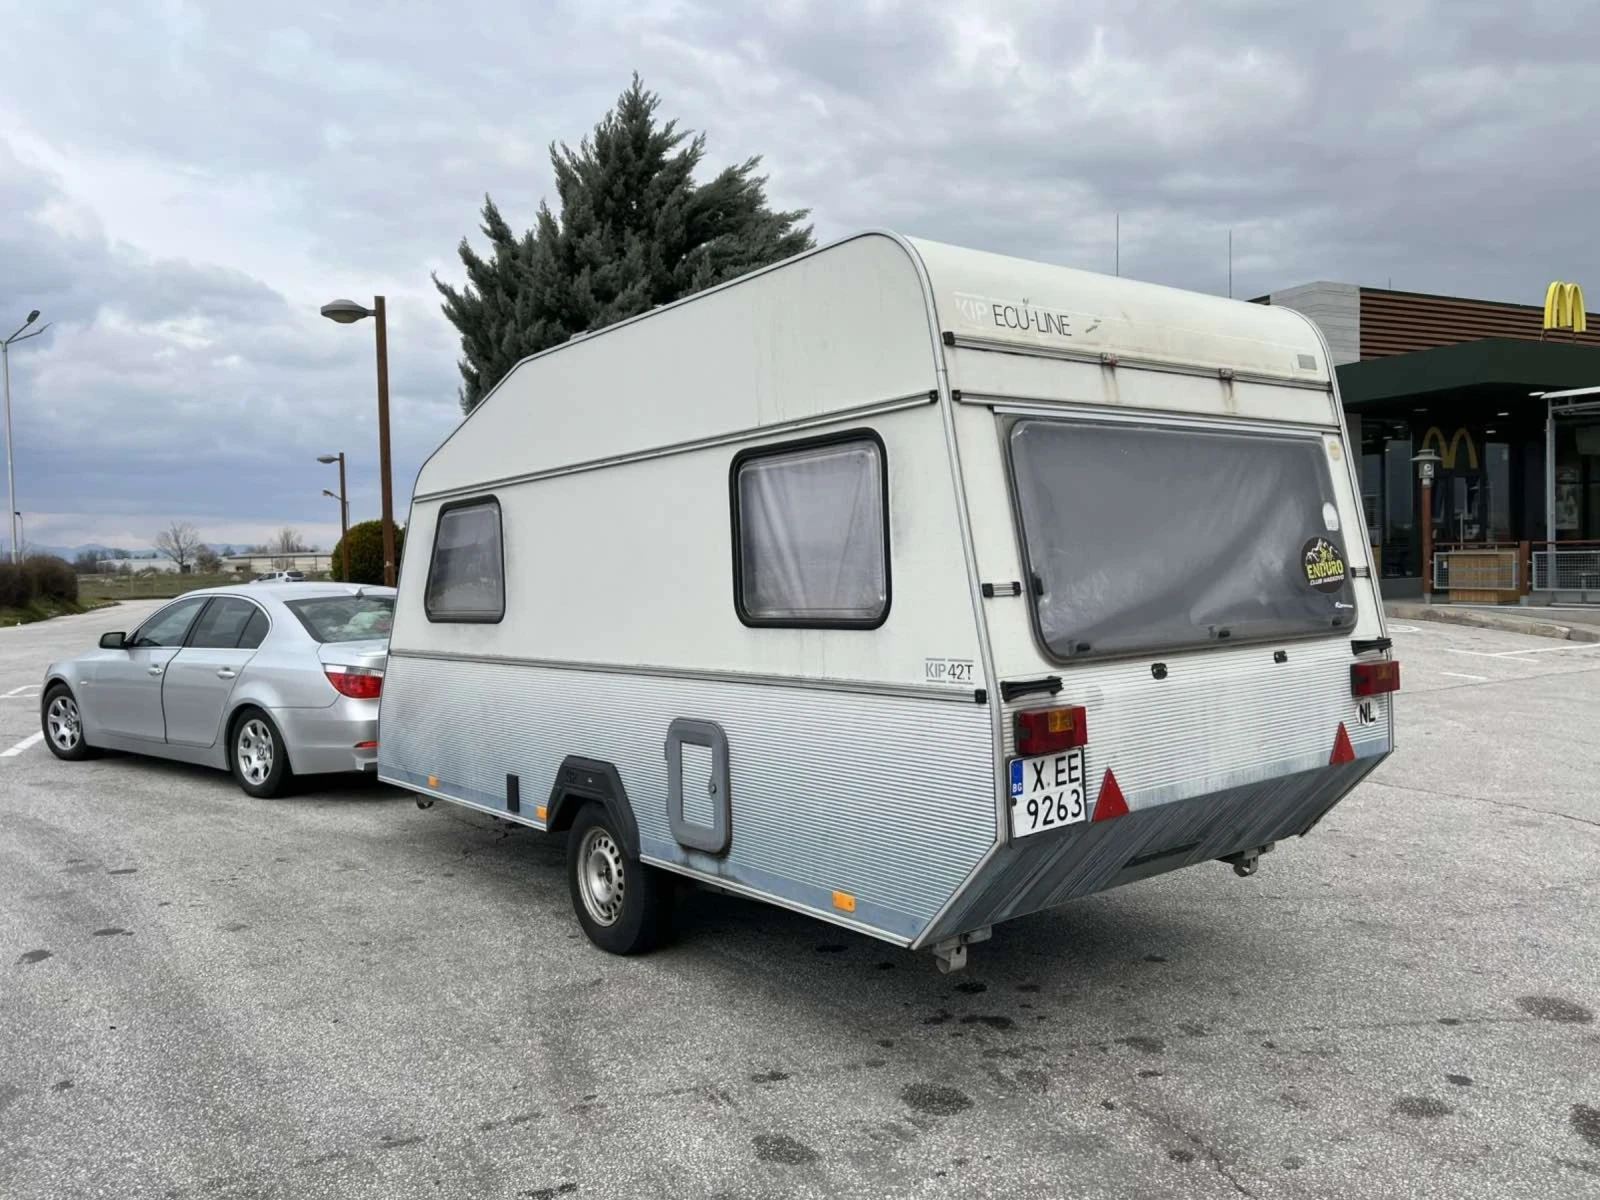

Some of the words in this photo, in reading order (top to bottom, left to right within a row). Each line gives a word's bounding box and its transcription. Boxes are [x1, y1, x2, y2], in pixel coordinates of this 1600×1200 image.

[992, 304, 1072, 337] ECU-LINE
[1307, 560, 1344, 579] ENDURO
[925, 662, 946, 678] KIP
[947, 663, 974, 680] 42T
[1359, 701, 1376, 724] NL
[1012, 782, 1023, 793] BG
[1026, 789, 1082, 829] 9263
